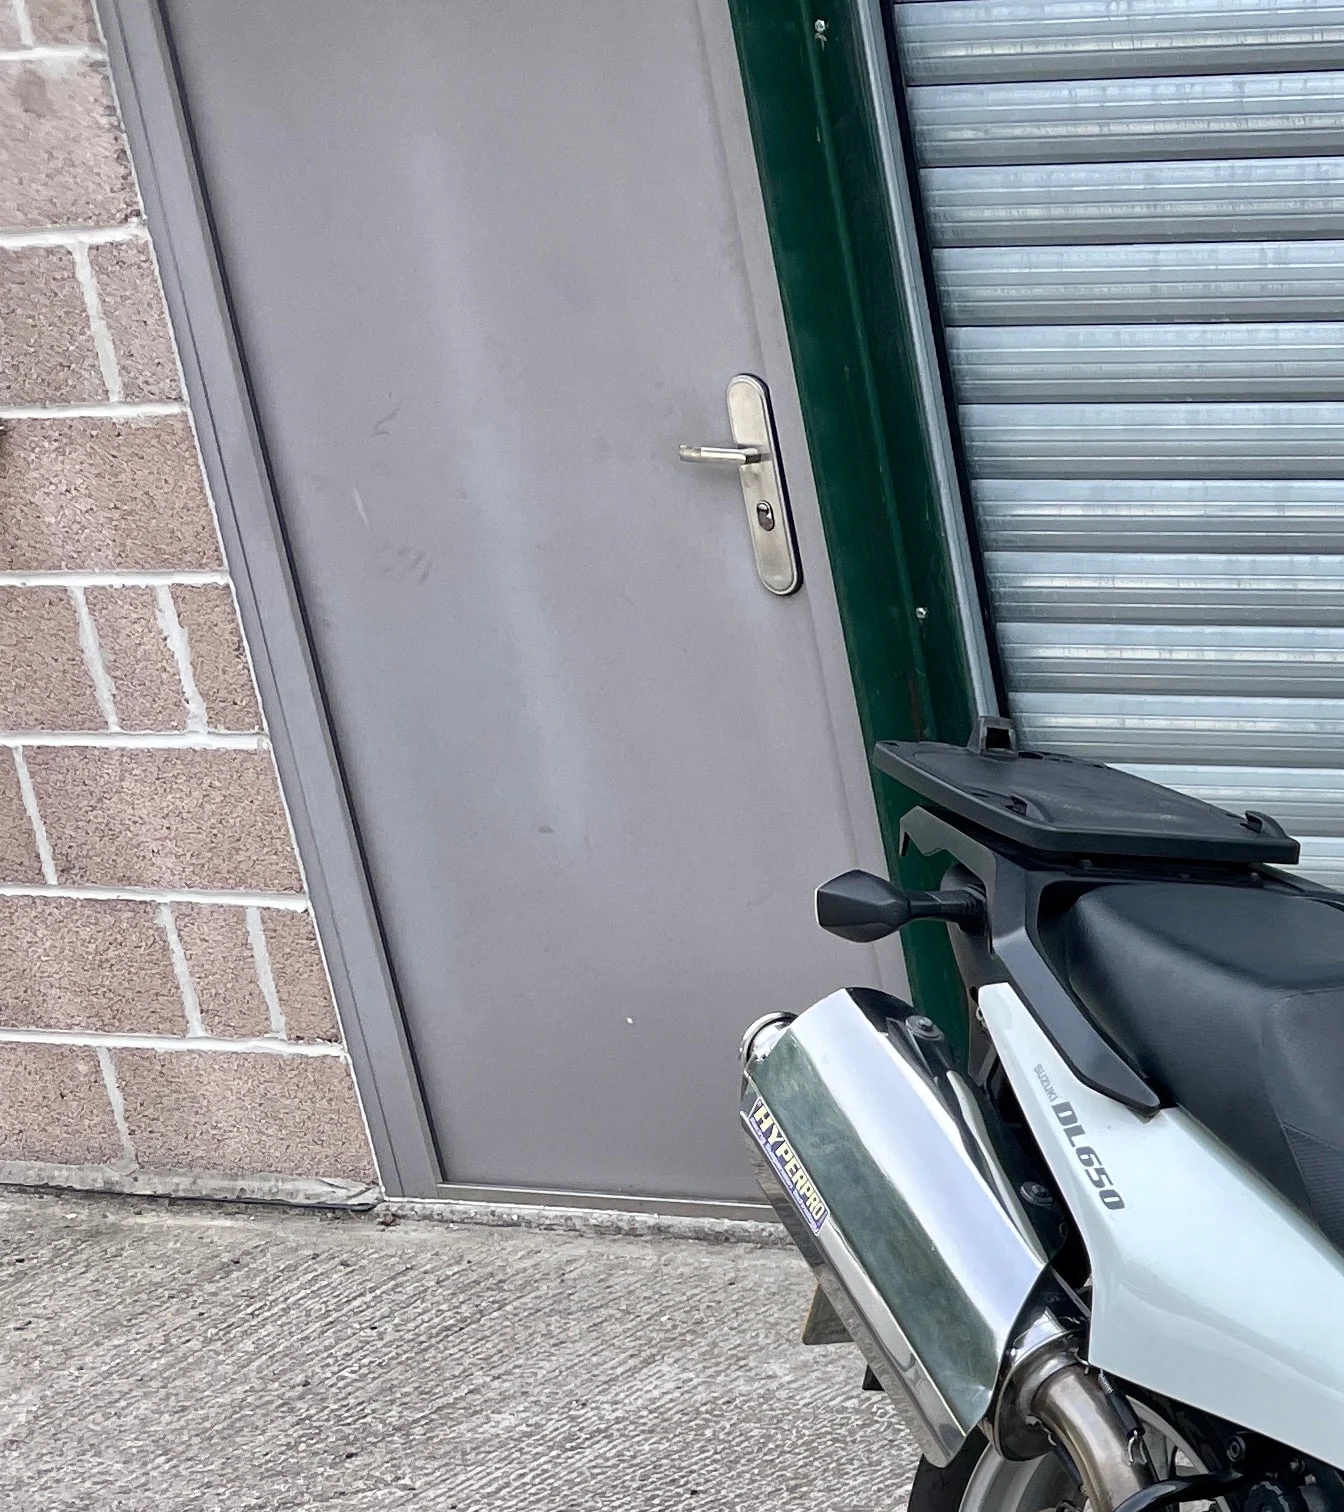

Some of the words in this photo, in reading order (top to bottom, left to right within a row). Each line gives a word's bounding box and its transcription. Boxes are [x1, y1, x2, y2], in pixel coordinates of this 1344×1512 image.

[753, 1105, 825, 1221] HYPERPRO
[1033, 1063, 1059, 1103] SUZUKI
[1052, 1101, 1126, 1210] DL650
